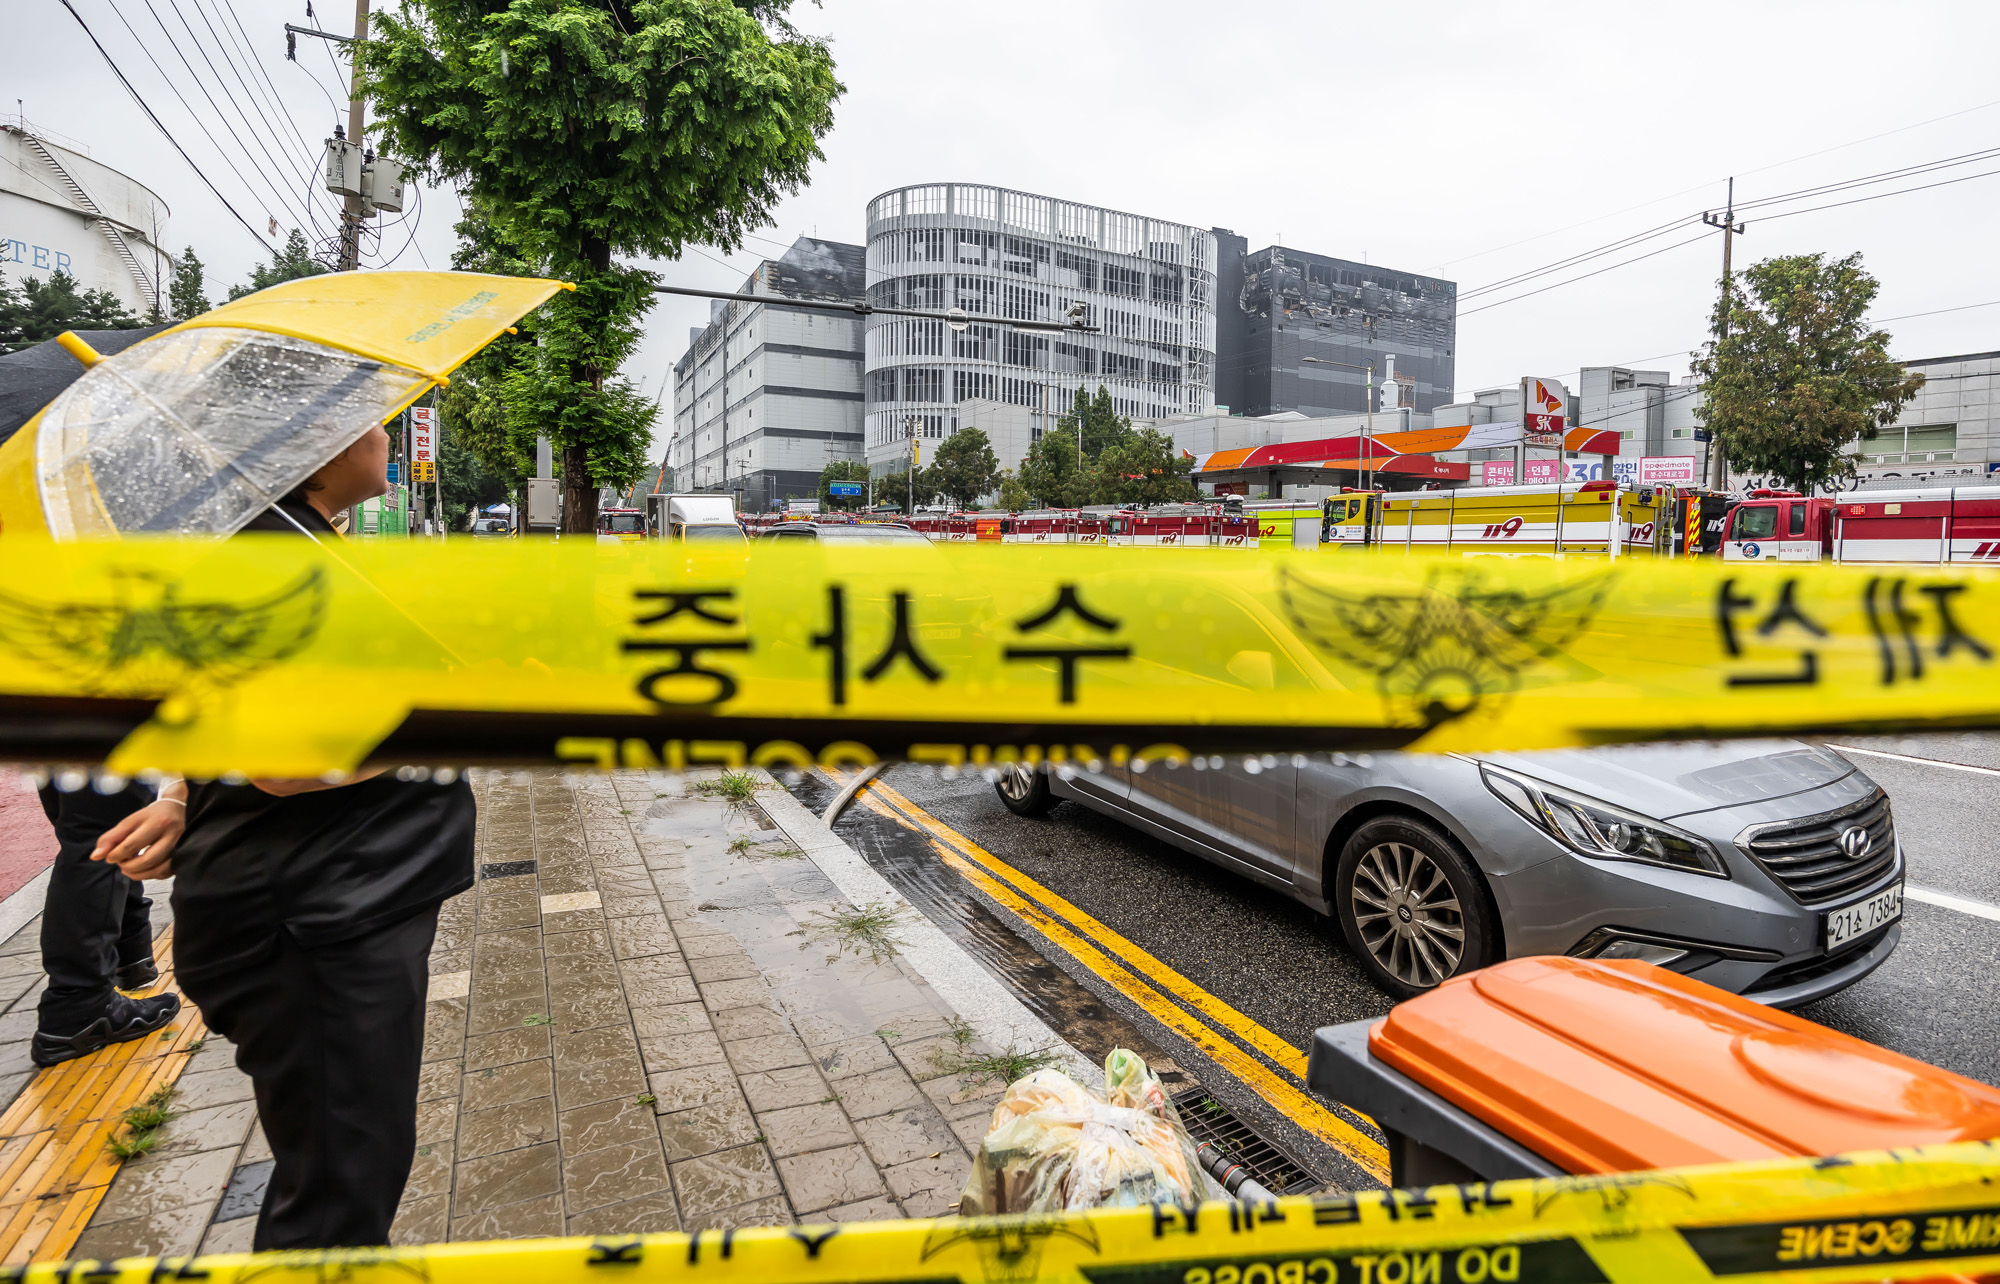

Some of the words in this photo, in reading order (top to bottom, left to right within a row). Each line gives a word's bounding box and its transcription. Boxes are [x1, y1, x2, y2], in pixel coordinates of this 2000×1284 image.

[0, 238, 73, 277] TER
[1536, 415, 1552, 431] SK
[416, 408, 430, 461] 금속전문
[1613, 463, 1637, 474] 할인
[1258, 525, 1276, 539] 119
[1482, 516, 1524, 539] 119
[1631, 520, 1654, 541] 119
[1706, 516, 1727, 532] 119
[951, 532, 966, 540] 119
[1080, 533, 1099, 542] 119
[1162, 532, 1178, 544] 119
[1225, 534, 1245, 545] 119
[1835, 914, 1863, 942] 21소
[1868, 889, 1897, 926] 7384
